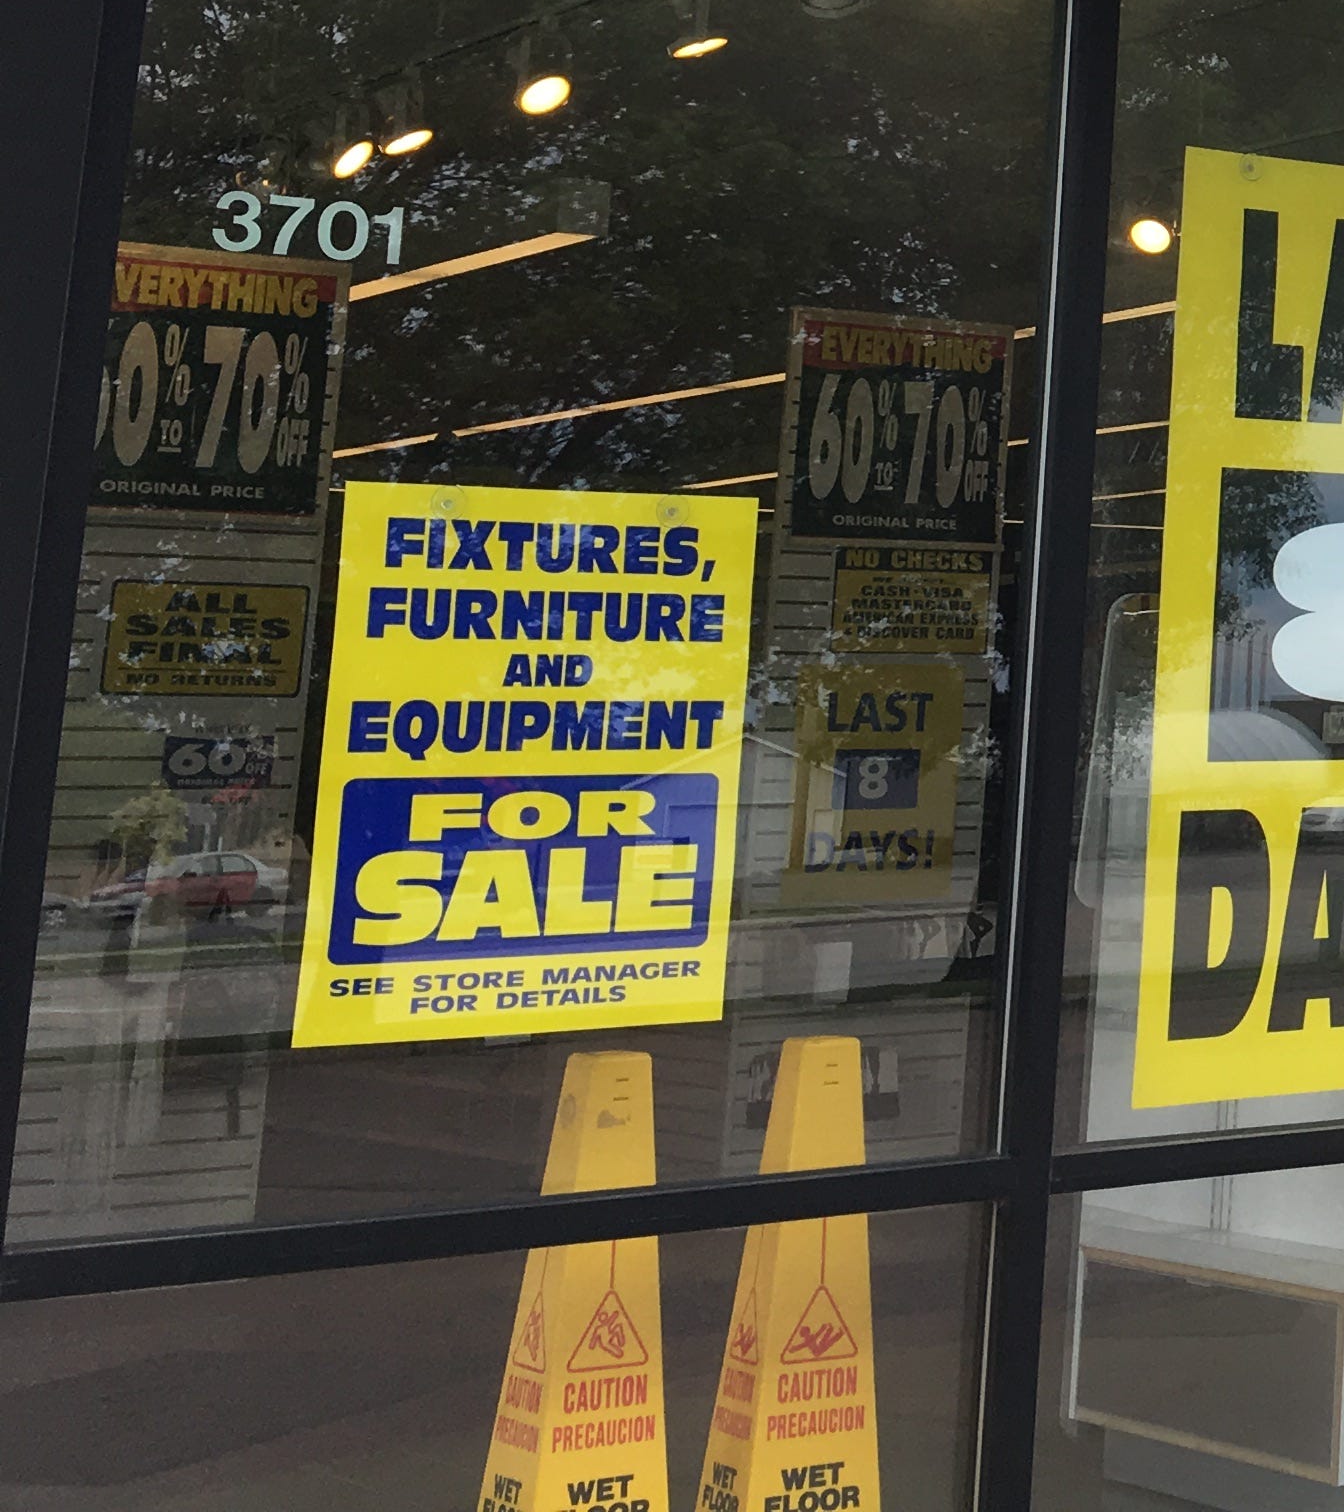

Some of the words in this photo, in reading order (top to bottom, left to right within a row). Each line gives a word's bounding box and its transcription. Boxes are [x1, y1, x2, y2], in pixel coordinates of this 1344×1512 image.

[212, 190, 405, 265] 3701
[114, 261, 319, 319] VERYTHING
[821, 325, 993, 374] EVERYTHING
[94, 321, 192, 467] 0%
[159, 419, 184, 448] TO
[195, 324, 310, 475] 70%
[276, 416, 310, 468] OFF
[808, 373, 899, 505] 60%
[874, 461, 895, 487] TO
[903, 380, 988, 509] 70%
[963, 459, 989, 502] OFF
[99, 478, 201, 497] ORIGINAL
[210, 485, 265, 500] PRICE
[832, 514, 910, 529] ORIGINAL
[915, 517, 958, 530] PRICE
[384, 516, 717, 582] FIXTURES,
[845, 549, 880, 568] NO
[891, 549, 984, 571] CHECKS
[165, 591, 258, 614] ALL
[851, 598, 972, 611] MASTERCARD
[860, 585, 910, 597] CASH
[923, 586, 965, 599] VISA
[125, 614, 291, 639] SALES
[366, 587, 725, 643] FURNITURE
[936, 627, 975, 640] CARD
[127, 641, 282, 665] FINAL
[503, 653, 593, 688] AND
[126, 672, 160, 685] NO
[171, 673, 277, 687] RETURNS
[346, 699, 725, 760] EQUIPMENT
[826, 692, 934, 732] LAST
[857, 756, 890, 800] 8
[408, 789, 657, 841] FOR
[804, 828, 936, 873] DAYS!
[352, 843, 699, 946] SALE
[329, 976, 396, 997] SEE
[412, 970, 526, 991] STORE
[541, 959, 701, 985] MANAGER
[408, 992, 480, 1014] FOR
[496, 984, 627, 1010] DETAILS
[562, 1373, 649, 1414] CAUTION
[777, 1366, 858, 1404] CAUTION
[551, 1414, 656, 1454] PRECAUCION
[767, 1405, 865, 1441] PRECAUCION
[494, 1473, 523, 1505] WET
[567, 1474, 635, 1506] WET
[712, 1461, 738, 1491] WET
[781, 1461, 845, 1492] WET
[702, 1484, 740, 1512] FLOOR
[765, 1485, 861, 1512] FLOOR
